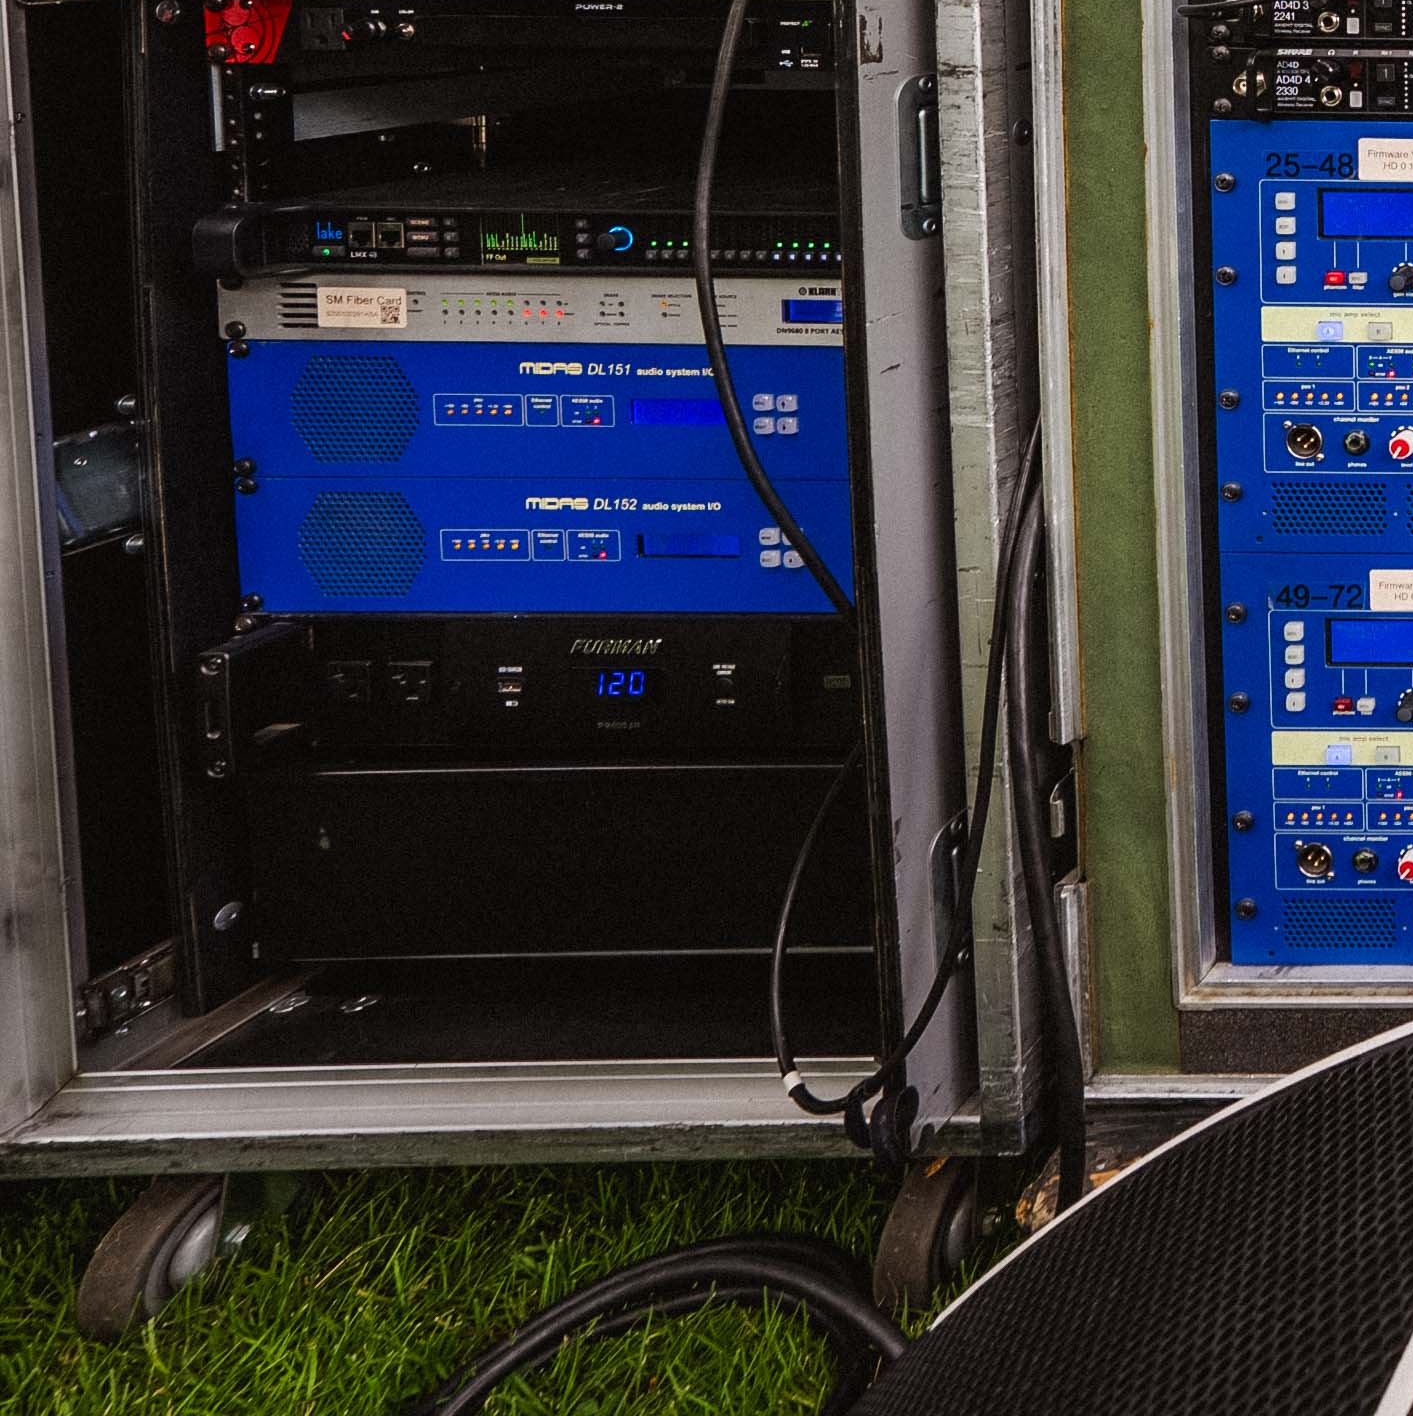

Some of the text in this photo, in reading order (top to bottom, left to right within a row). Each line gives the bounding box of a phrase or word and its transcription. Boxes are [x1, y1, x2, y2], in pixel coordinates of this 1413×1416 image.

[1274, 1, 1309, 10] AD4D 3
[1274, 12, 1294, 20] 2241
[1277, 60, 1299, 68] AD4D
[1276, 75, 1302, 84] AD4D
[1276, 86, 1298, 95] 2330
[1367, 149, 1408, 159] Firmware
[1265, 152, 1354, 178] 25-48
[1383, 161, 1397, 170] HD
[317, 222, 342, 239] lake
[326, 295, 402, 306] SM Fiber Card
[520, 362, 582, 375] MIDAS
[588, 363, 630, 375] DL151
[666, 369, 700, 377] system
[526, 497, 721, 512] MIDAS DL152 audio system I/O
[1275, 584, 1364, 609] 49-72
[1394, 593, 1408, 601] HD
[570, 638, 663, 655] FURMAN
[598, 672, 644, 695] 120
